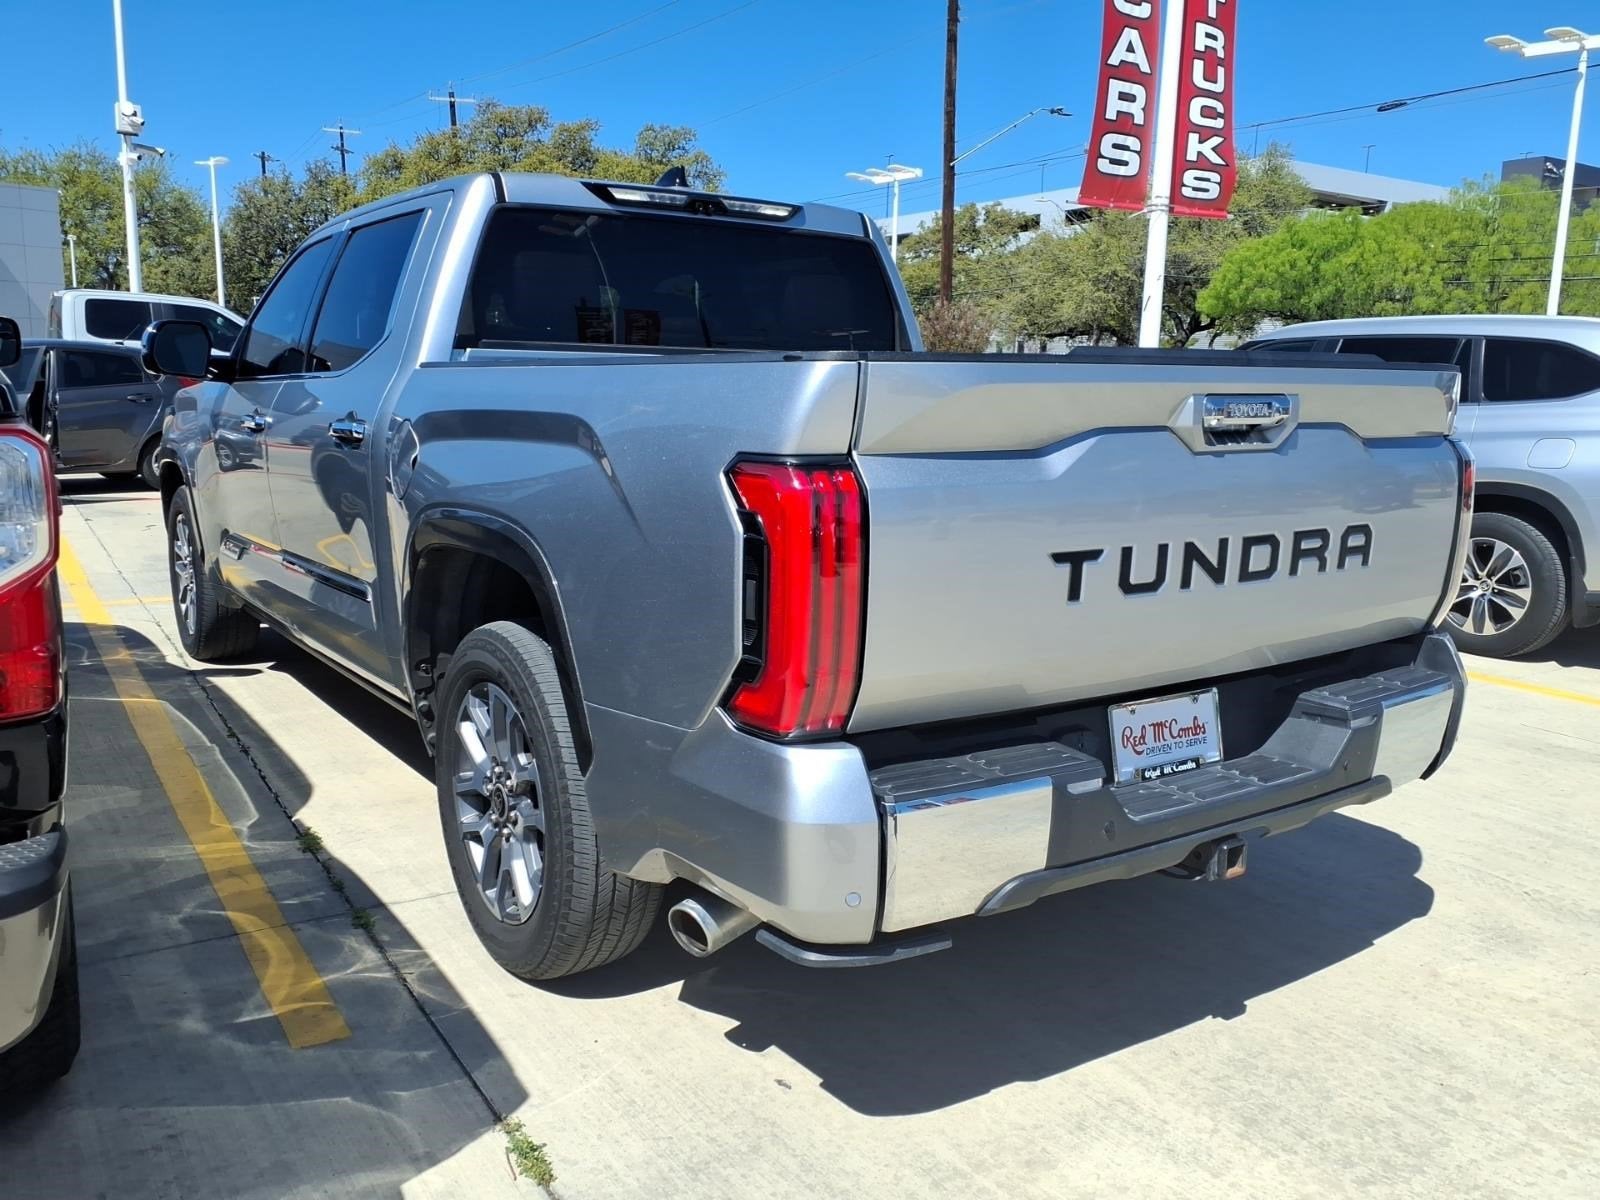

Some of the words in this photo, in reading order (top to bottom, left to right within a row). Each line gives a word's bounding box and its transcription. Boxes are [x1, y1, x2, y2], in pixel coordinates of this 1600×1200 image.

[1229, 403, 1270, 417] TOYOTA
[1050, 523, 1373, 603] TUNDRA
[1121, 725, 1147, 756] Red
[1148, 716, 1206, 743] McCombs
[1145, 743, 1172, 756] DRIVEN
[1174, 741, 1184, 749] TO
[1185, 736, 1208, 748] SERVE
[1144, 767, 1161, 779] Red
